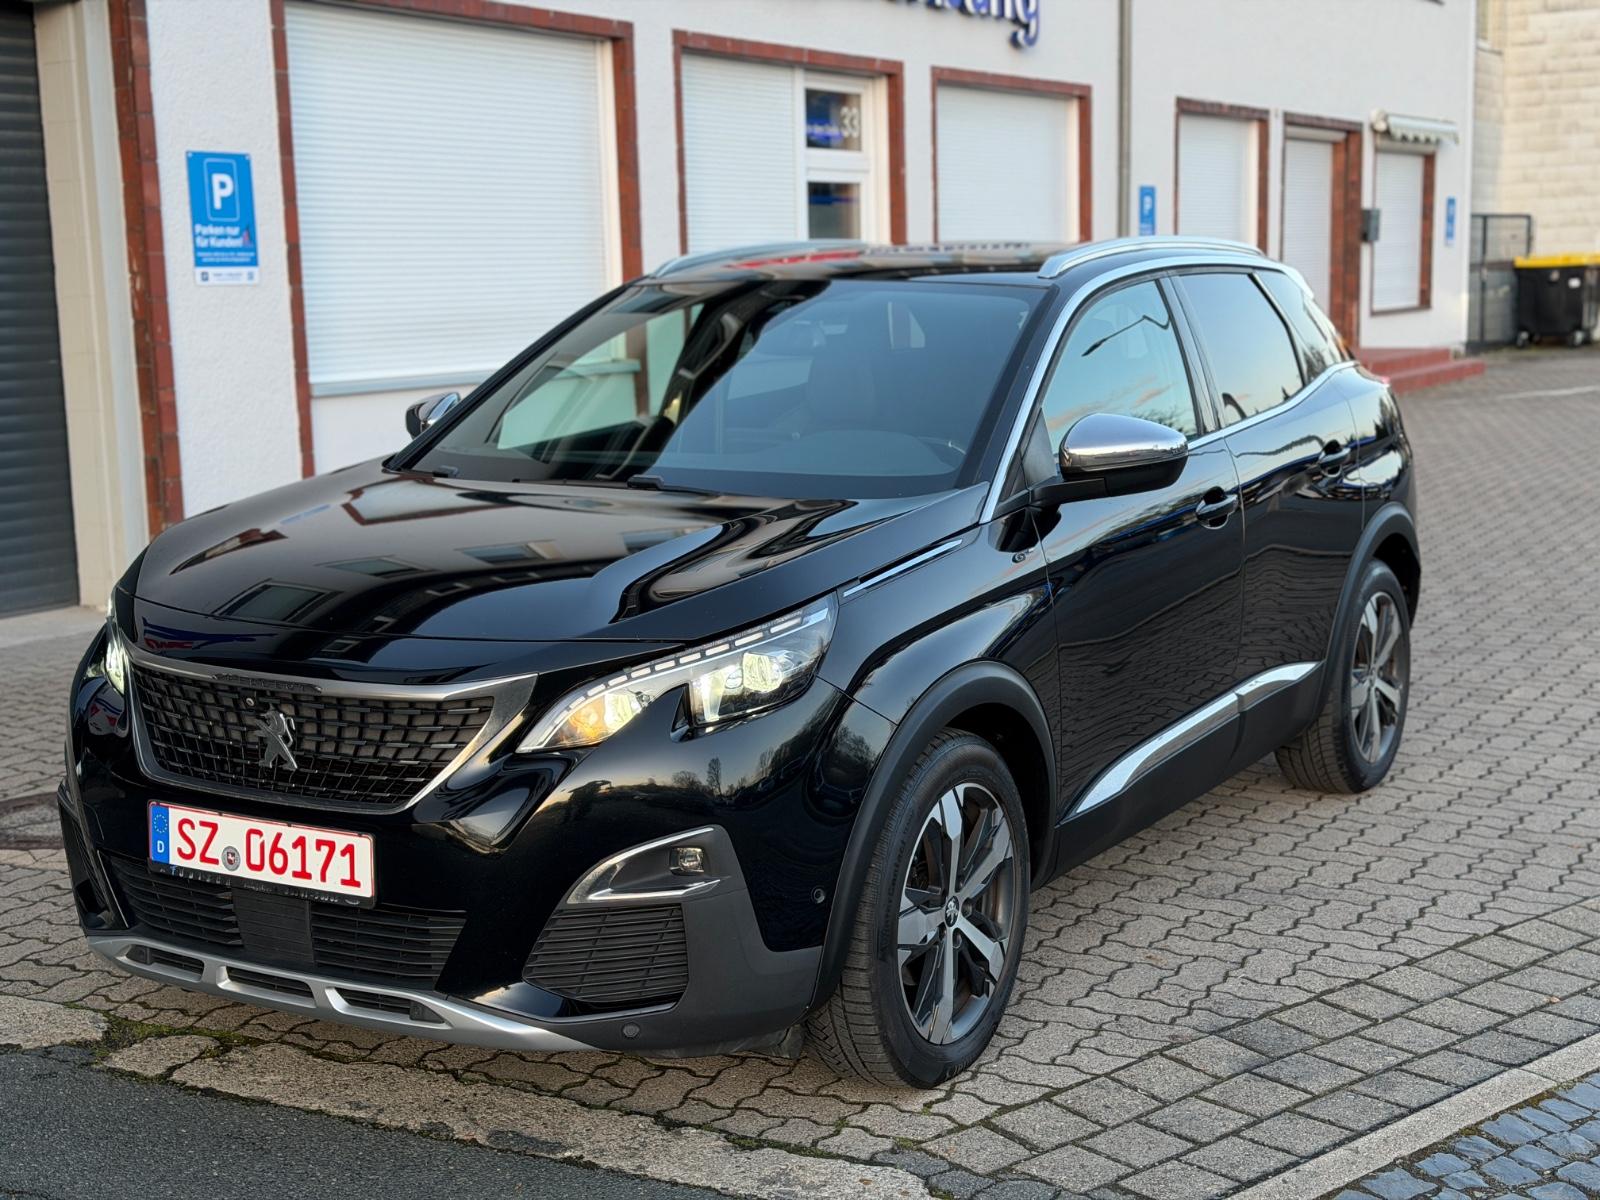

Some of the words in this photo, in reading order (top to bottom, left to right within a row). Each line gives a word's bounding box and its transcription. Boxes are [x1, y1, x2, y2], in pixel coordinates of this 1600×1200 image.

[840, 106, 860, 138] 33
[211, 172, 234, 211] P
[156, 840, 165, 854] D
[176, 817, 220, 866] SZ
[245, 827, 362, 889] 06171
